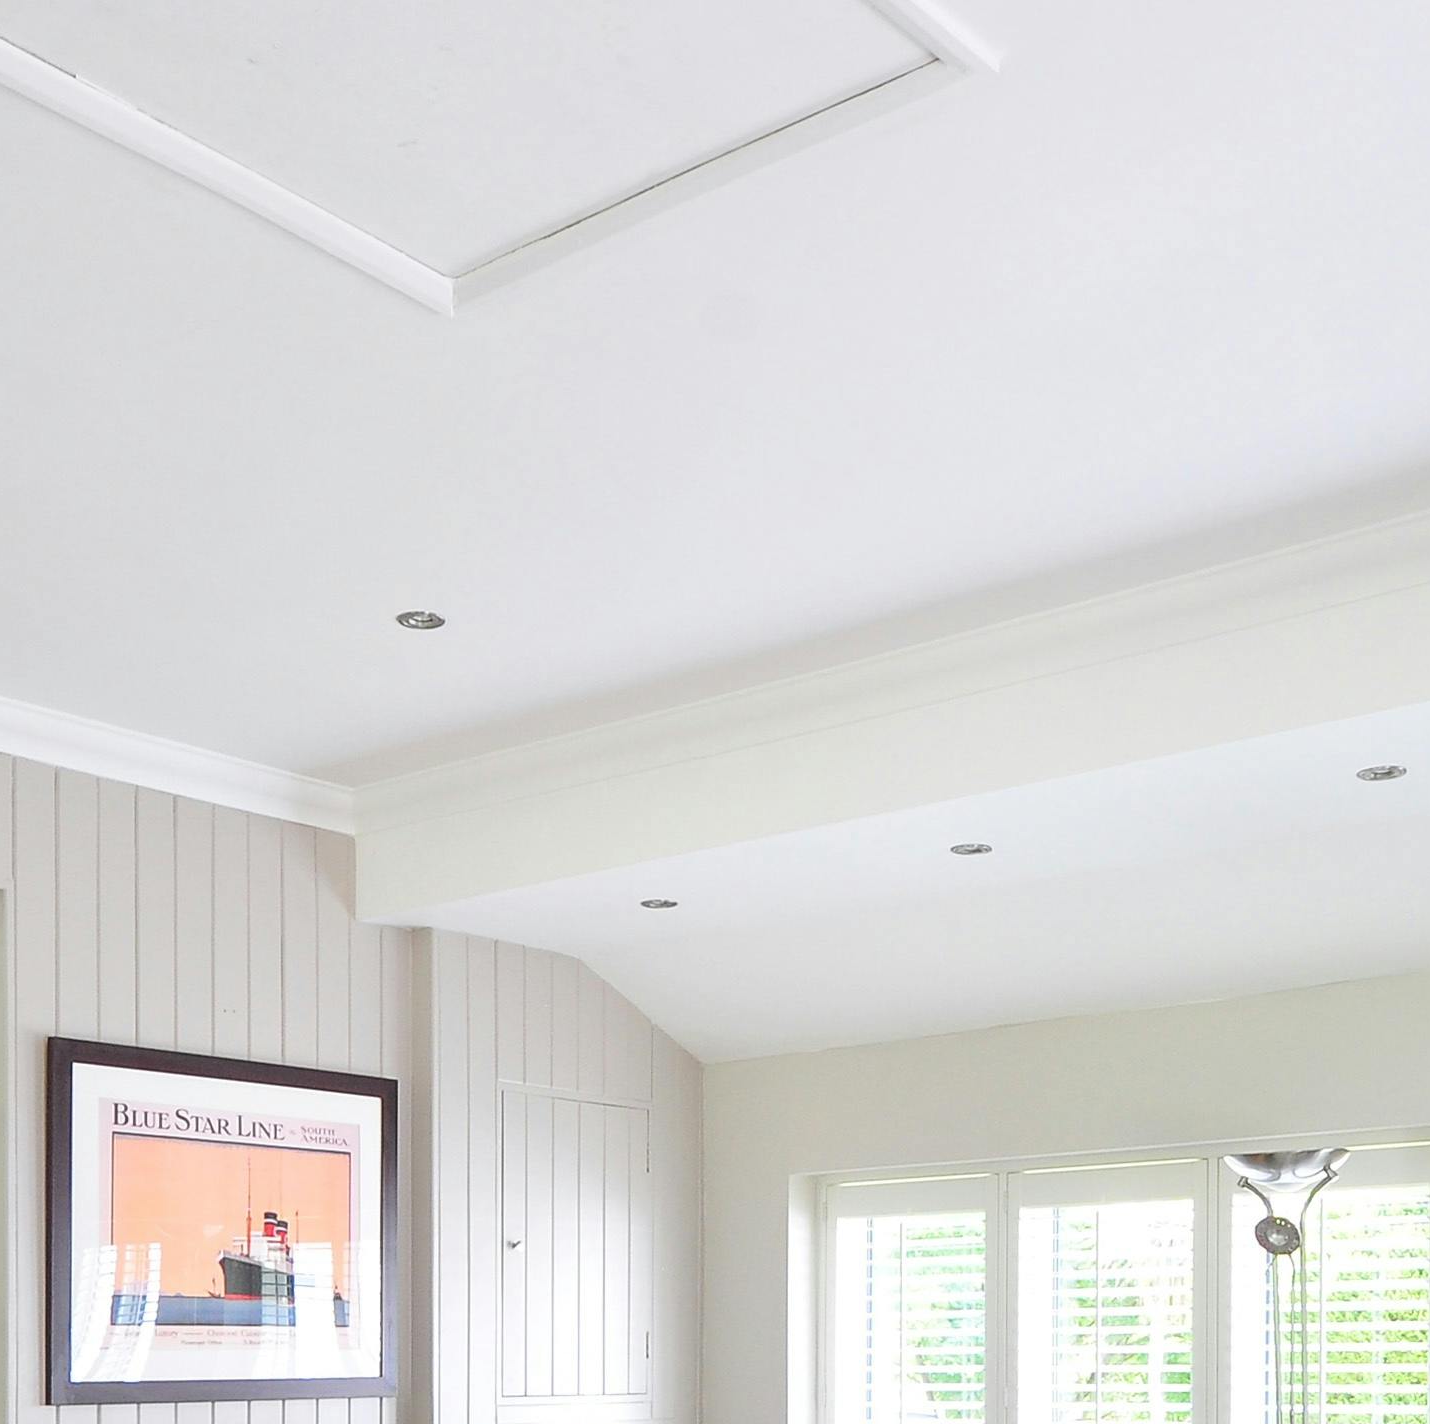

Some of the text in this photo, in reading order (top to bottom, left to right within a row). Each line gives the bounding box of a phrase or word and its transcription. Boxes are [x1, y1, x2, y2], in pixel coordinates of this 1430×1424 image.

[113, 1102, 286, 1141] BLUE STAR LINE
[300, 1126, 335, 1137] SOUTH
[301, 1134, 349, 1147] AMERICA
